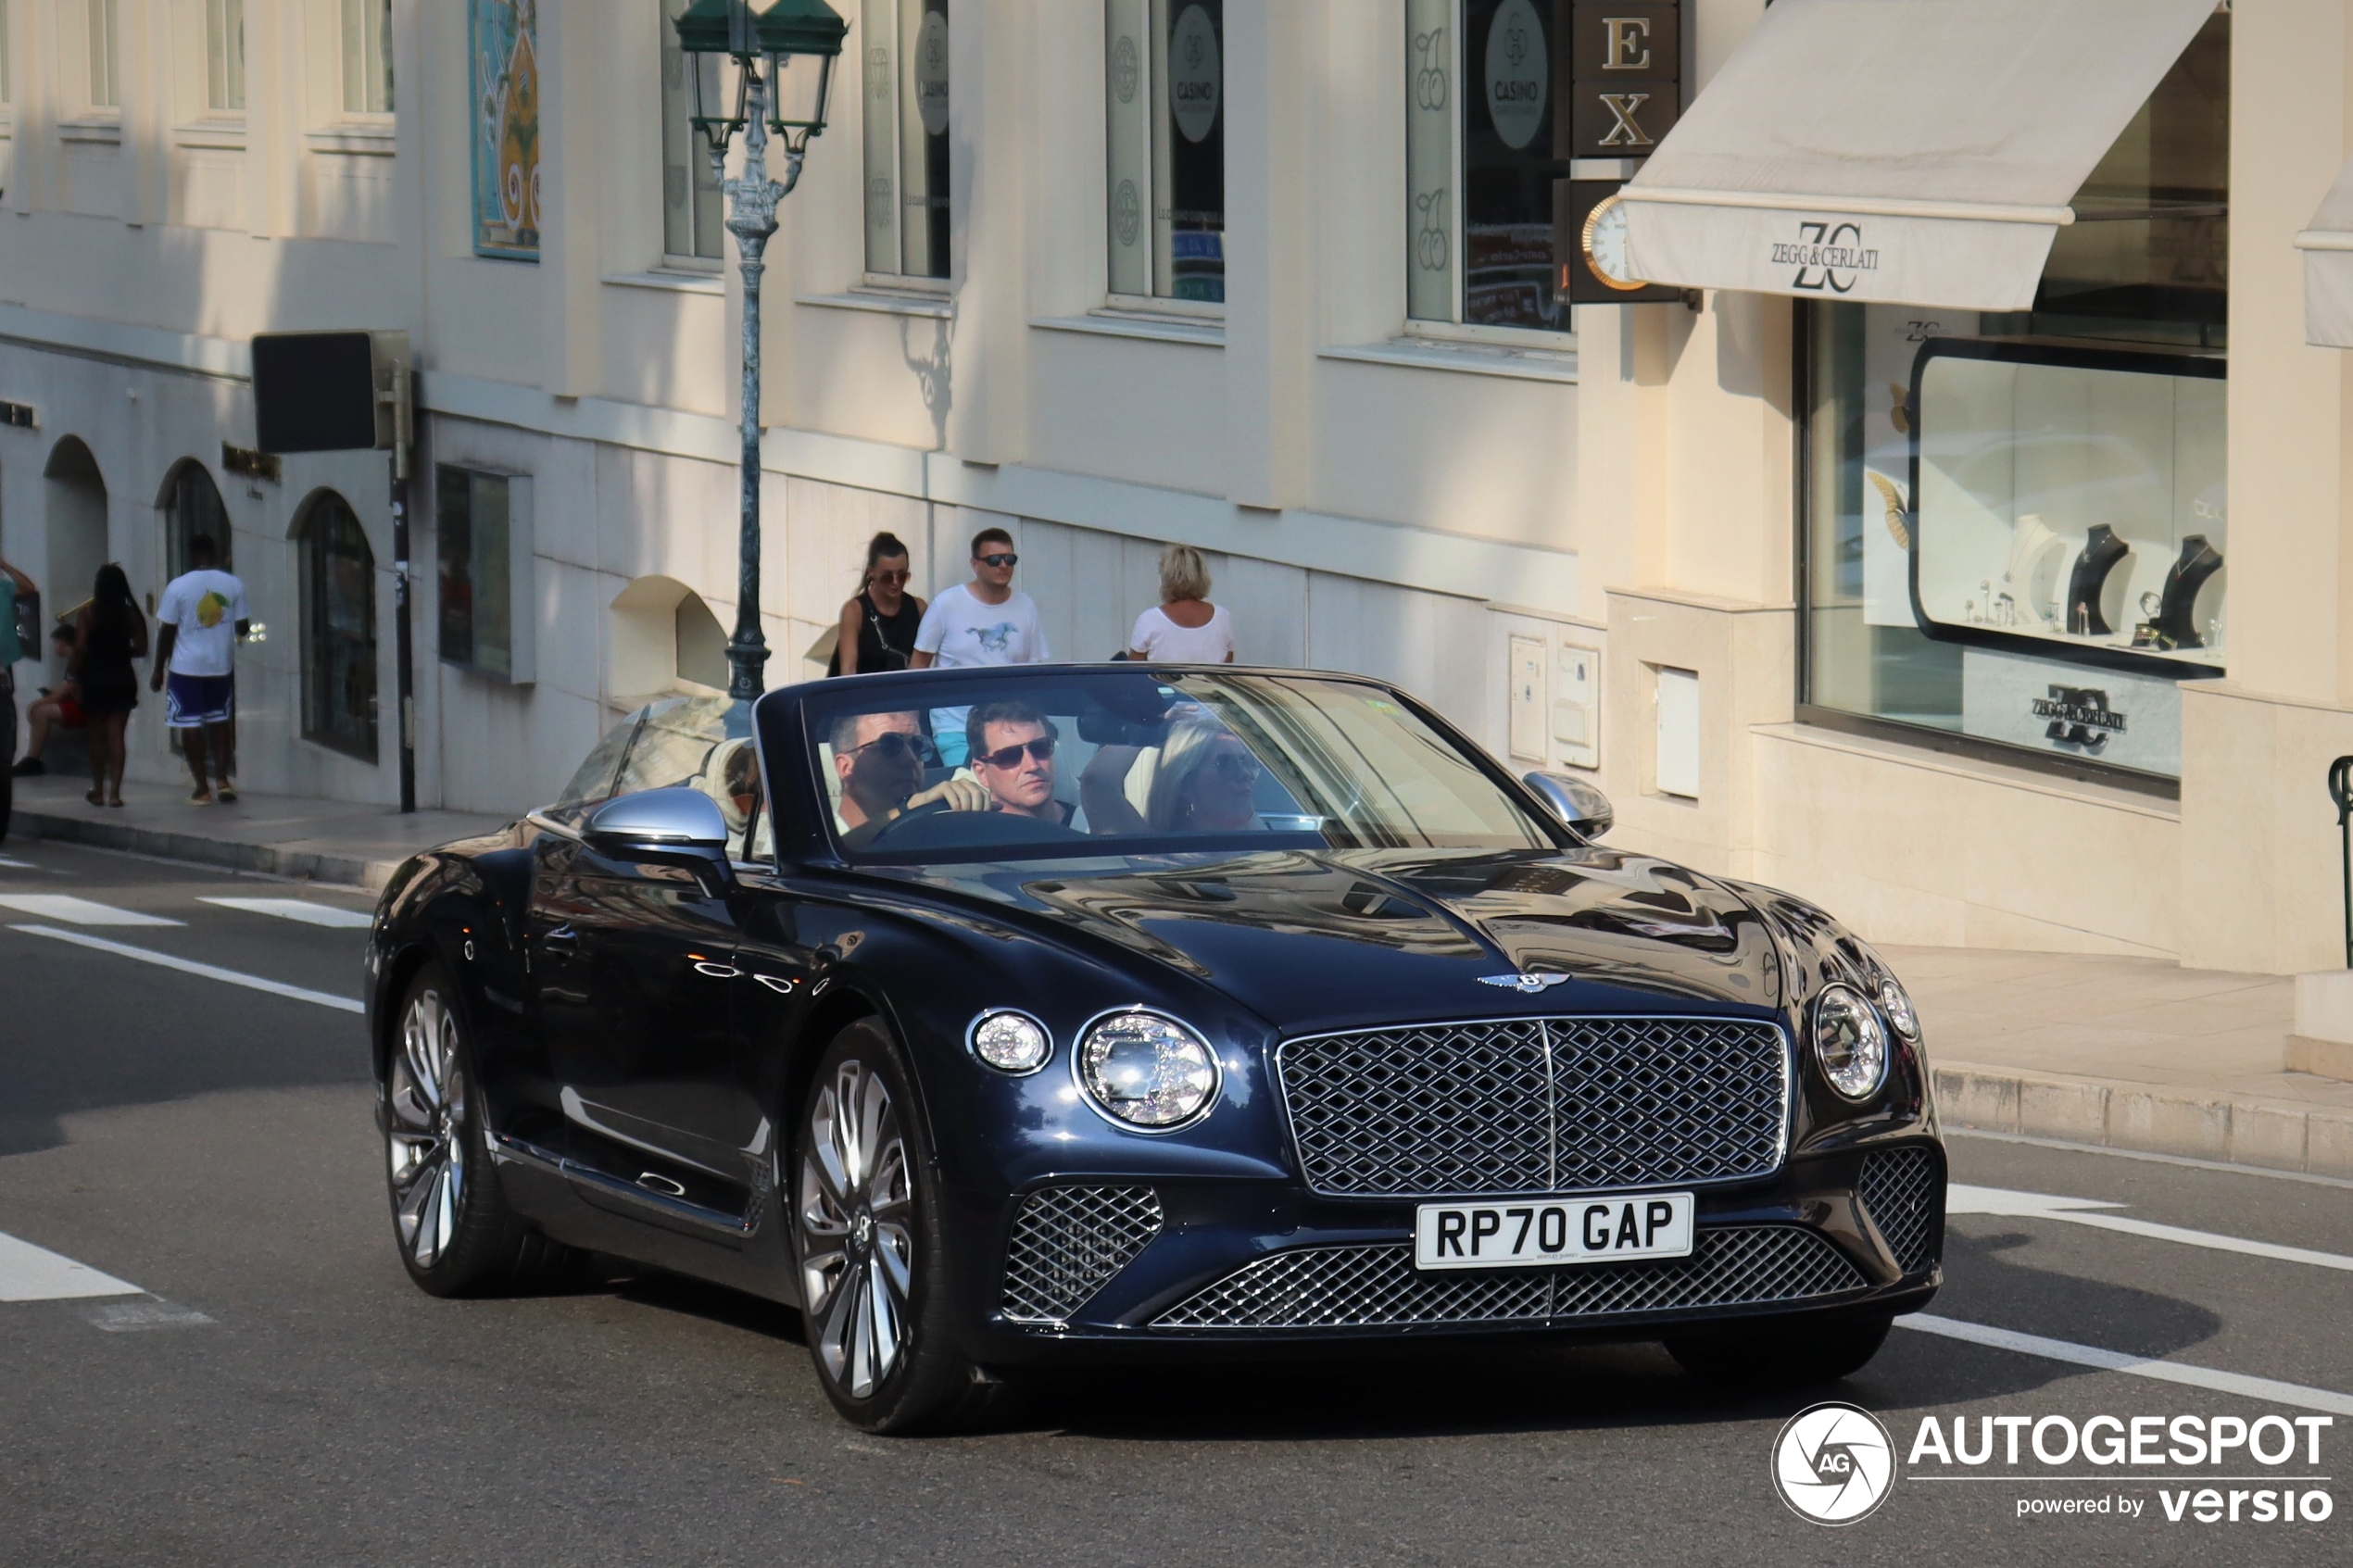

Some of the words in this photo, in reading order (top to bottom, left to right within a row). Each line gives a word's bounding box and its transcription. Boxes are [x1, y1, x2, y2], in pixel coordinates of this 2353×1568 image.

[1176, 81, 1212, 101] CASINO
[1494, 80, 1538, 102] CASINO
[1770, 243, 1808, 265] ZEGG
[1809, 245, 1821, 267] &
[1821, 246, 1880, 270] CERLATI
[1437, 1207, 1567, 1258] RP70
[1582, 1201, 1673, 1252] GAP
